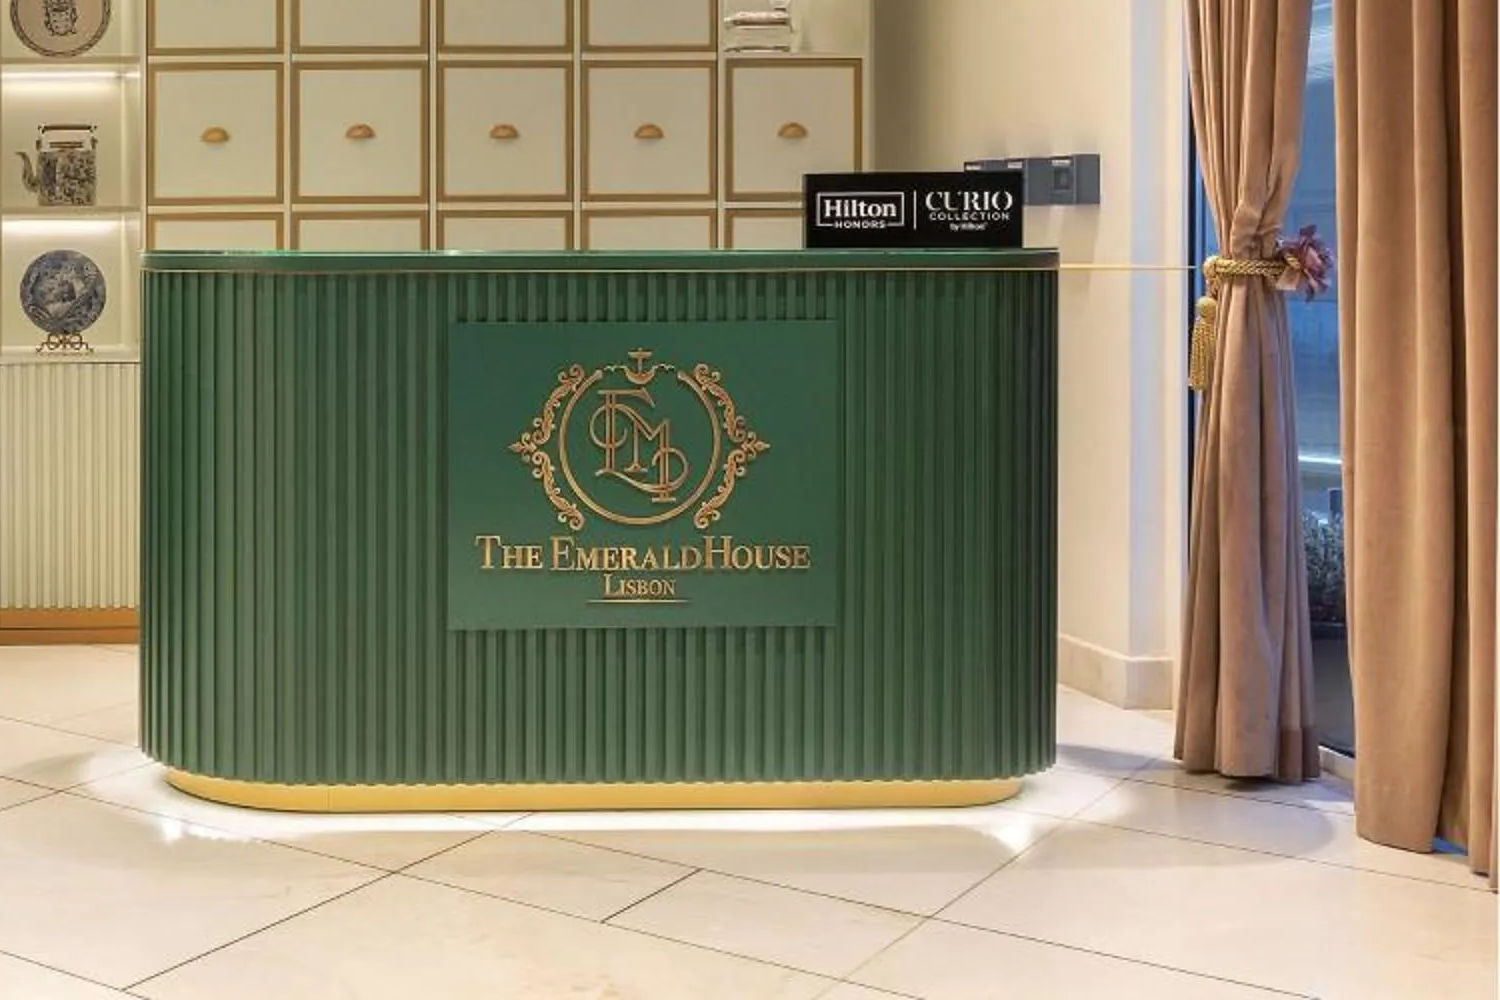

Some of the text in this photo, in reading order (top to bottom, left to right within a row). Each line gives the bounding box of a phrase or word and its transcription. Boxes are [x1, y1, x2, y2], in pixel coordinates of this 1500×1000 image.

[824, 199, 897, 217] Hilton
[925, 191, 1013, 211] CURIO
[834, 220, 886, 229] HONORS
[929, 211, 1010, 221] COLLECTION
[475, 535, 543, 569] THE
[603, 573, 677, 596] LISBON
